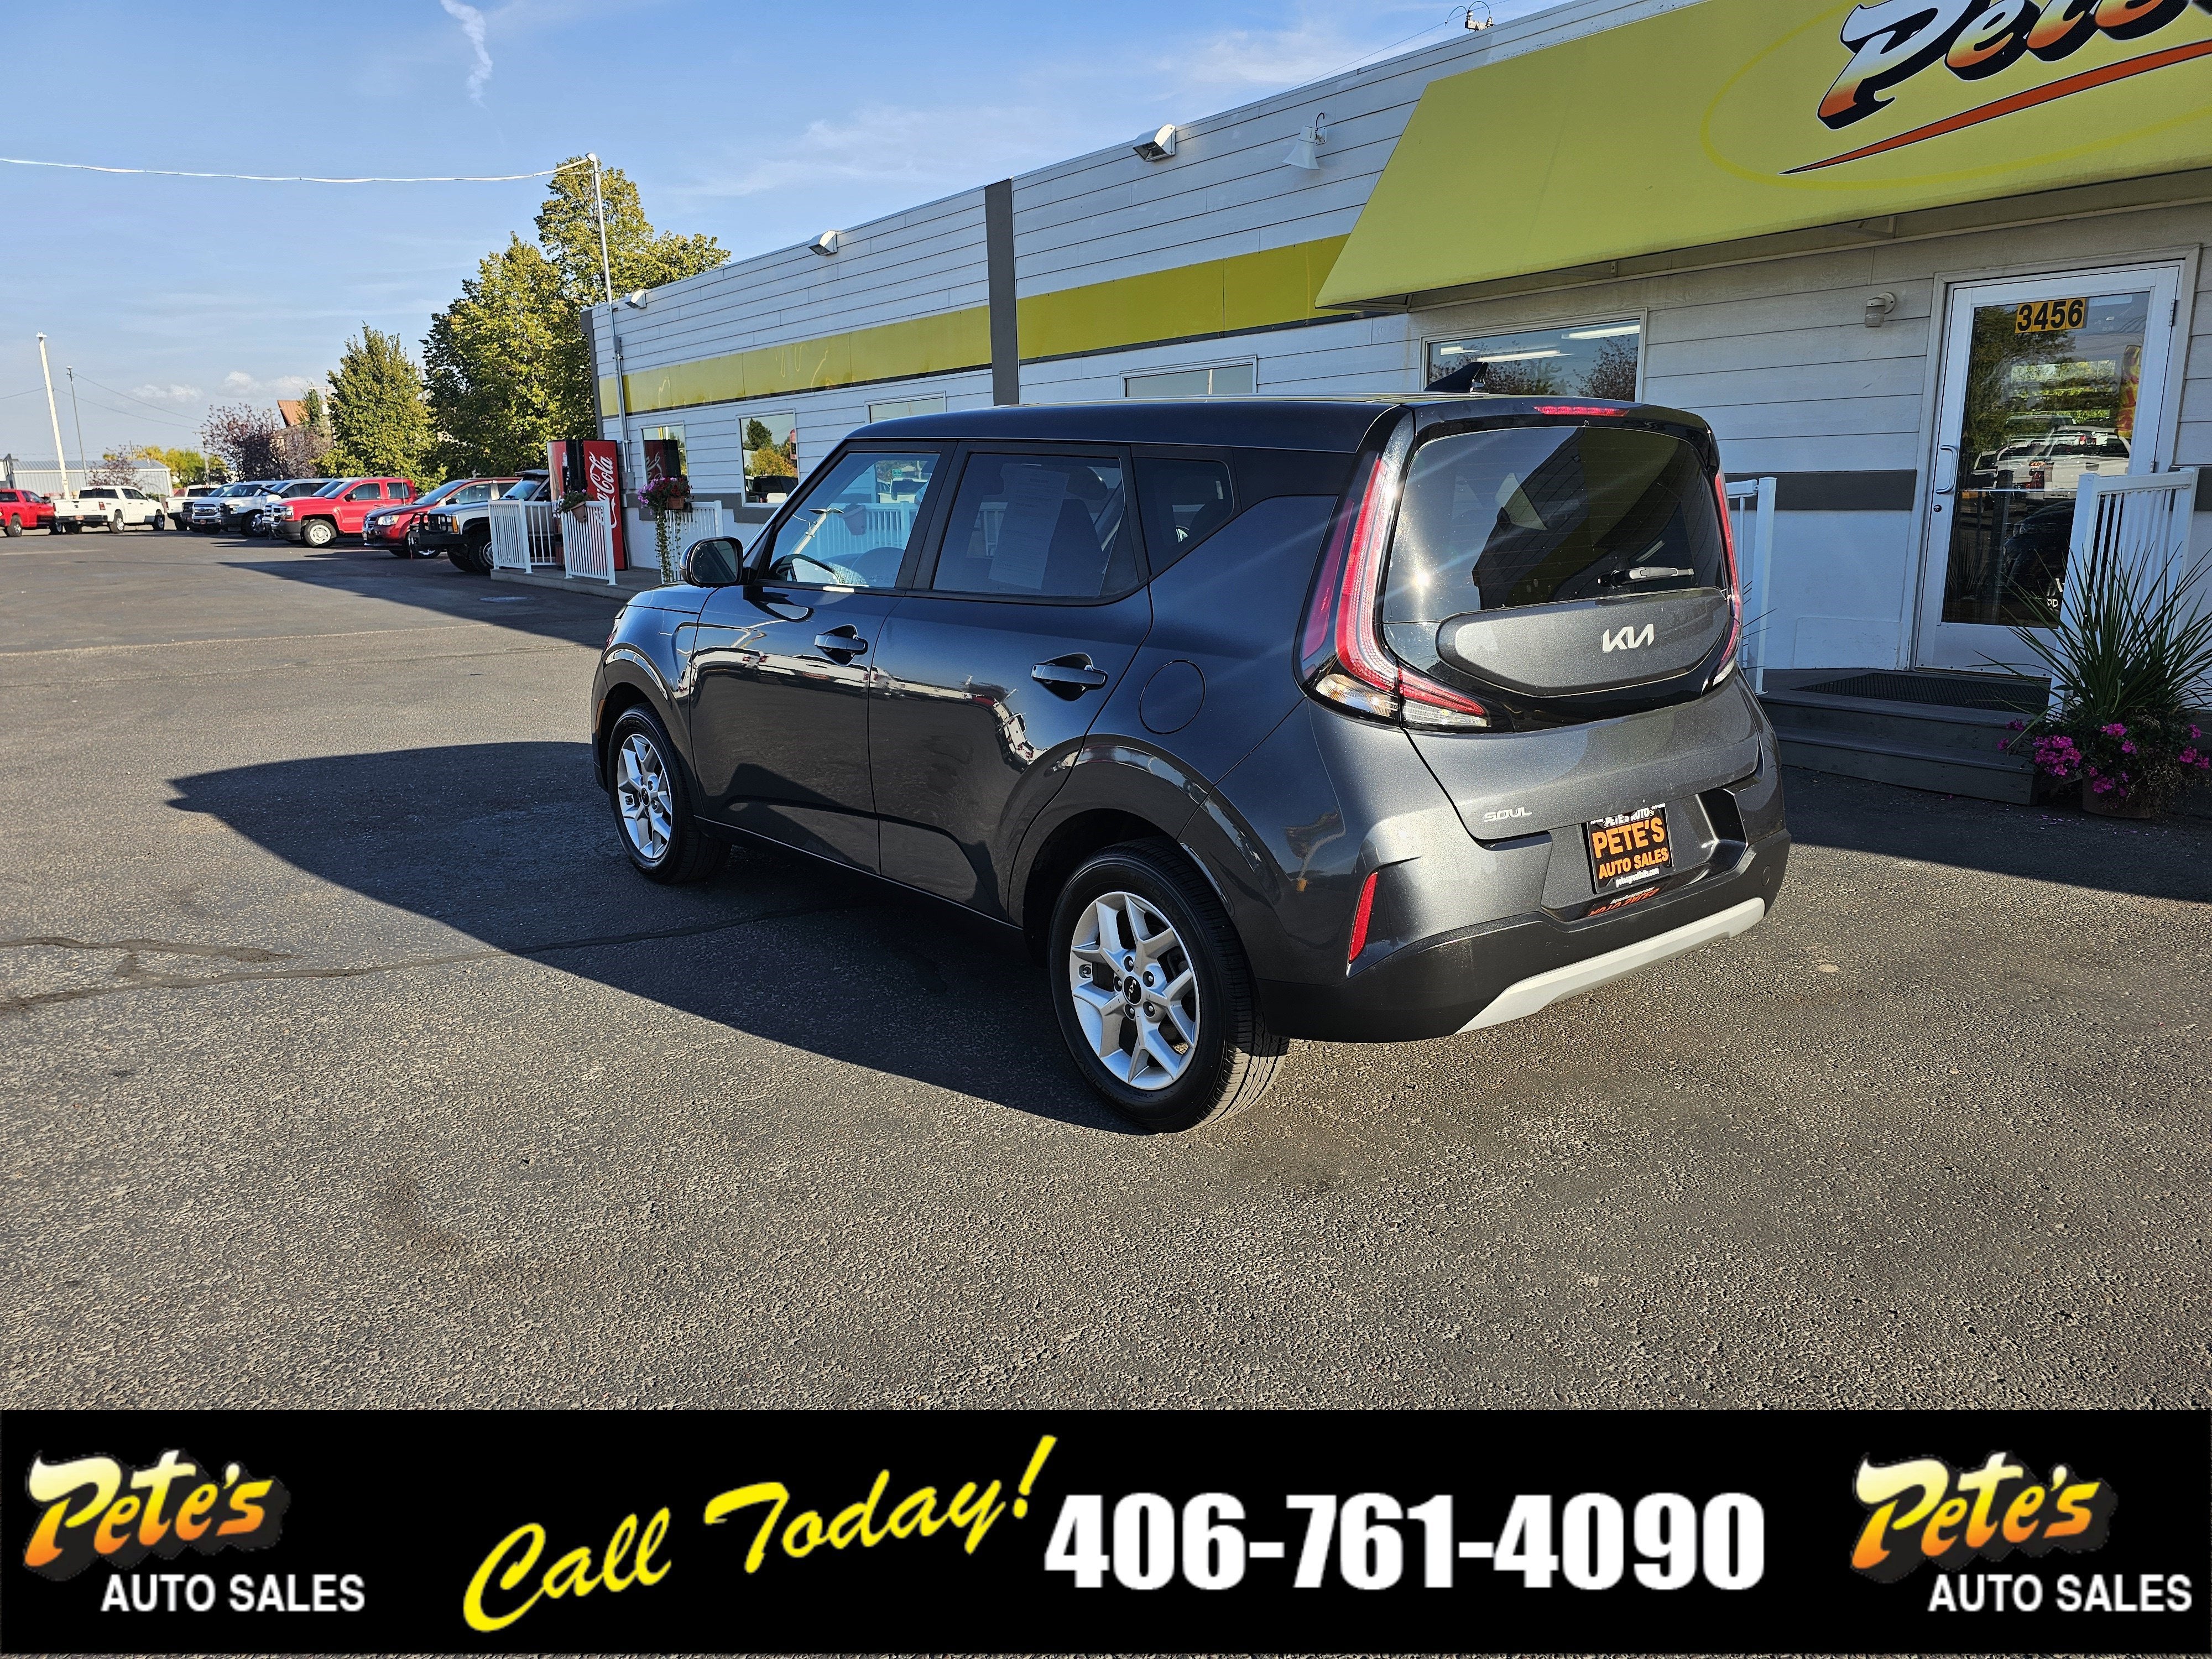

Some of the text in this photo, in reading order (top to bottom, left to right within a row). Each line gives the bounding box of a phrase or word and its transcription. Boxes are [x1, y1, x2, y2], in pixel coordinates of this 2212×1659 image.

[2017, 299, 2083, 331] 3456
[1602, 623, 1655, 653] KIA
[1483, 807, 1532, 822] SOUL
[1592, 817, 1665, 858] PETE'S
[1599, 847, 1670, 879] AUTO SALES
